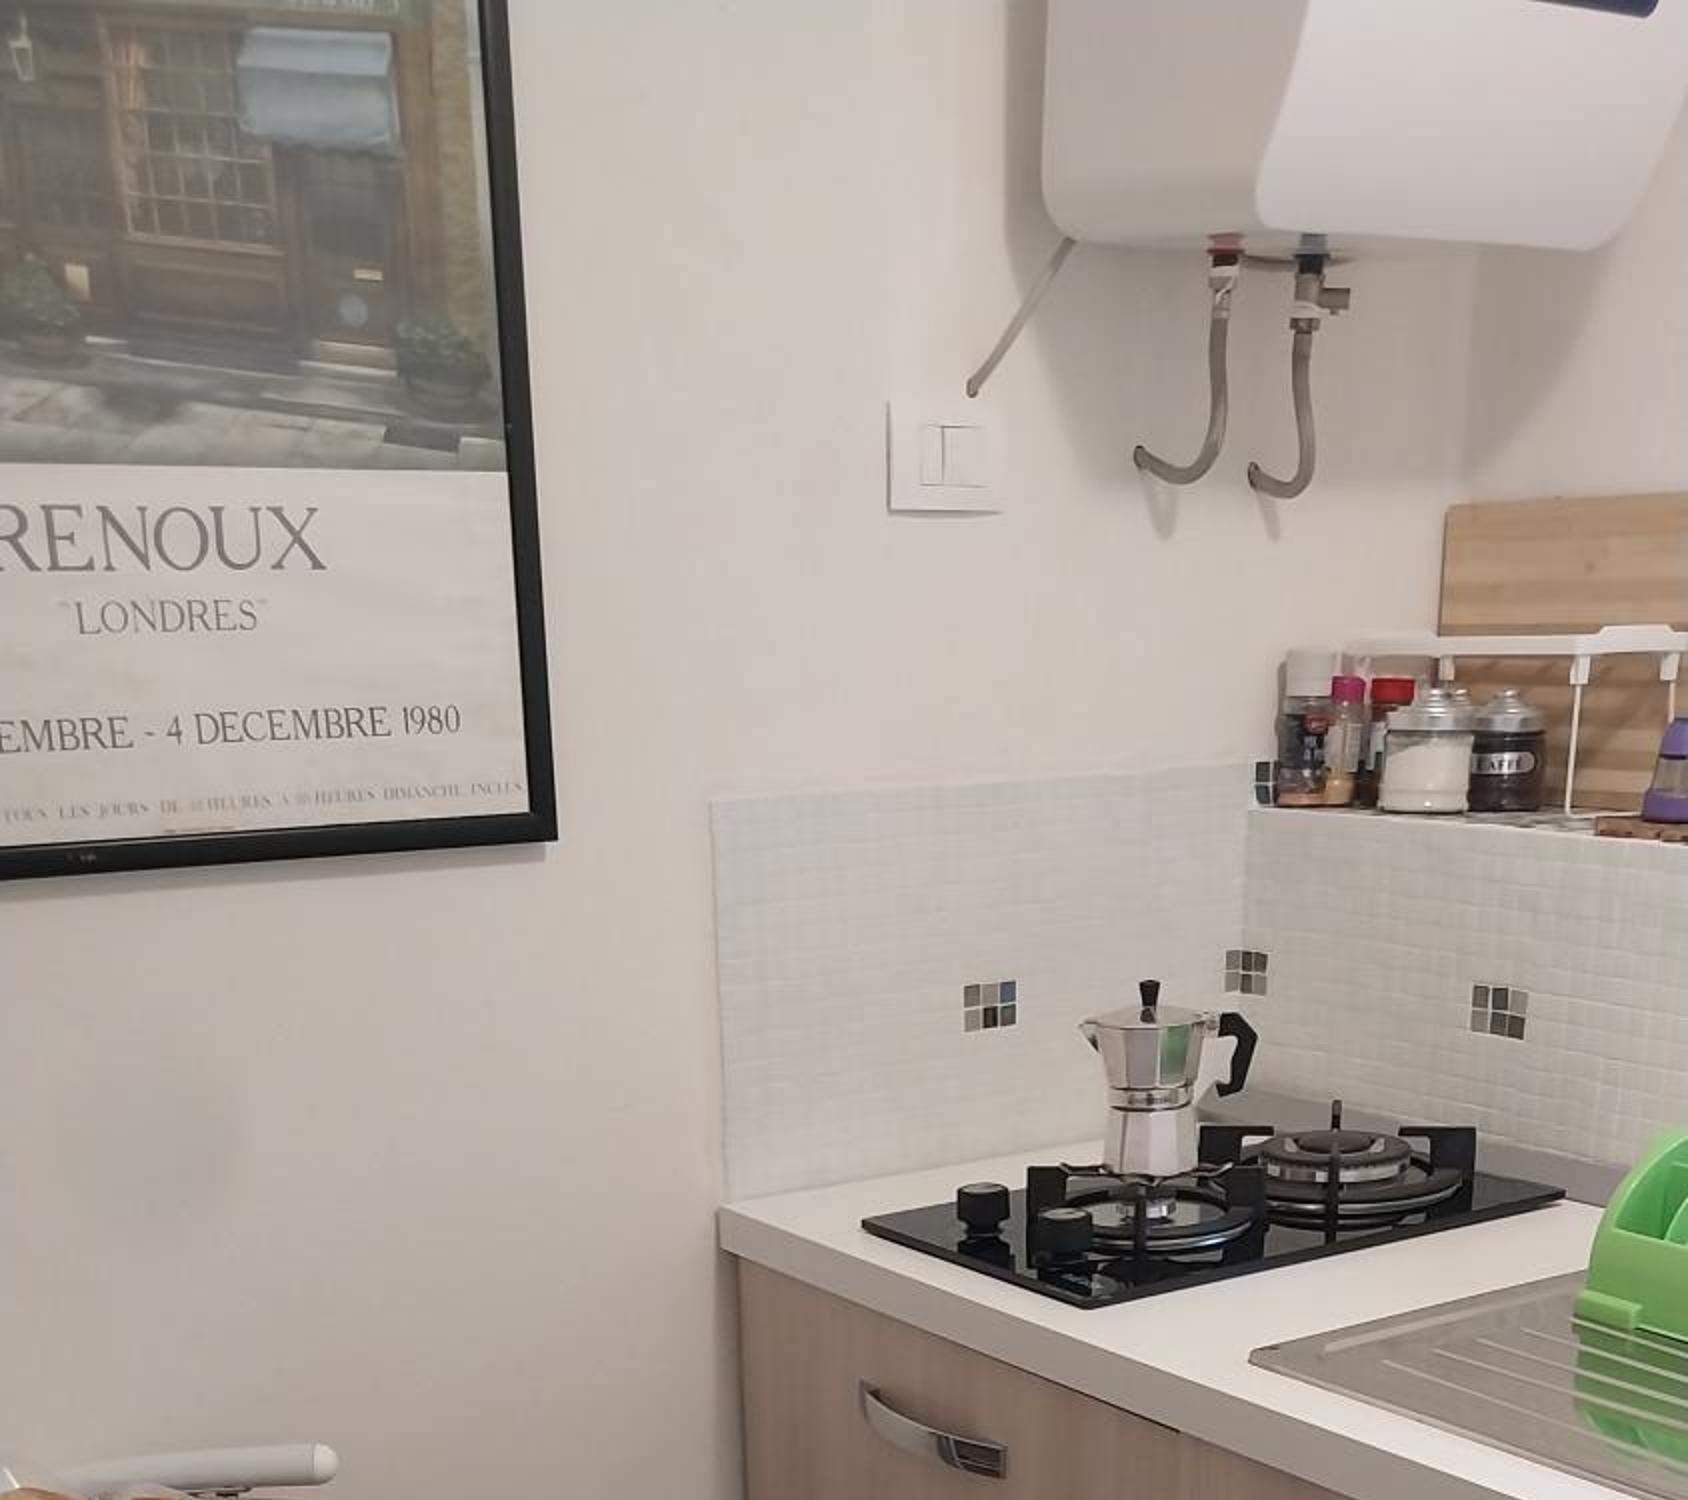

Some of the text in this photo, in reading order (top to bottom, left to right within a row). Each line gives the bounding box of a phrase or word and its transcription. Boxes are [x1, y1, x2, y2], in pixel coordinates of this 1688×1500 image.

[0, 504, 327, 572] RENOUX
[166, 714, 182, 745] 4
[195, 706, 392, 744] DECEMBRE
[402, 704, 460, 735] 1980
